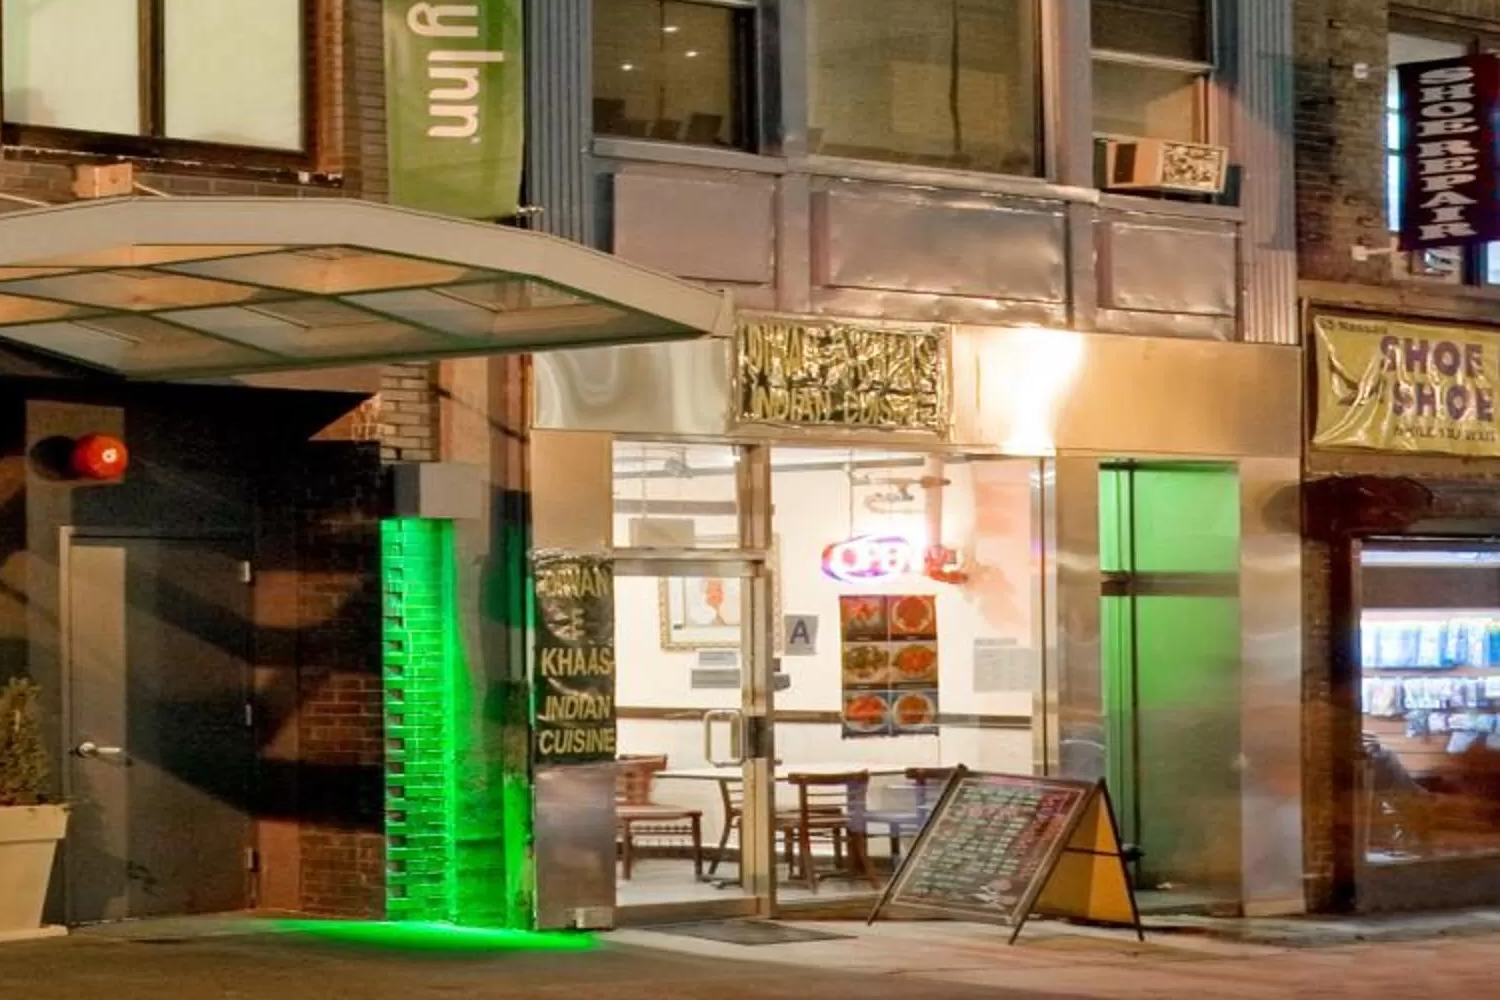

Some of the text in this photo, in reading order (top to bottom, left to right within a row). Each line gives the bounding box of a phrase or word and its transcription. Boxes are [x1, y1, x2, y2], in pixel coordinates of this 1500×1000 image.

[427, 49, 504, 139] Inn
[1416, 65, 1480, 241] SHOE REPAIR
[1380, 335, 1484, 378] SHOE
[1392, 383, 1493, 422] SHOE
[789, 618, 811, 645] A
[541, 647, 613, 677] KHAAS
[546, 694, 611, 721] INDIAN
[539, 728, 615, 755] CUISINE
